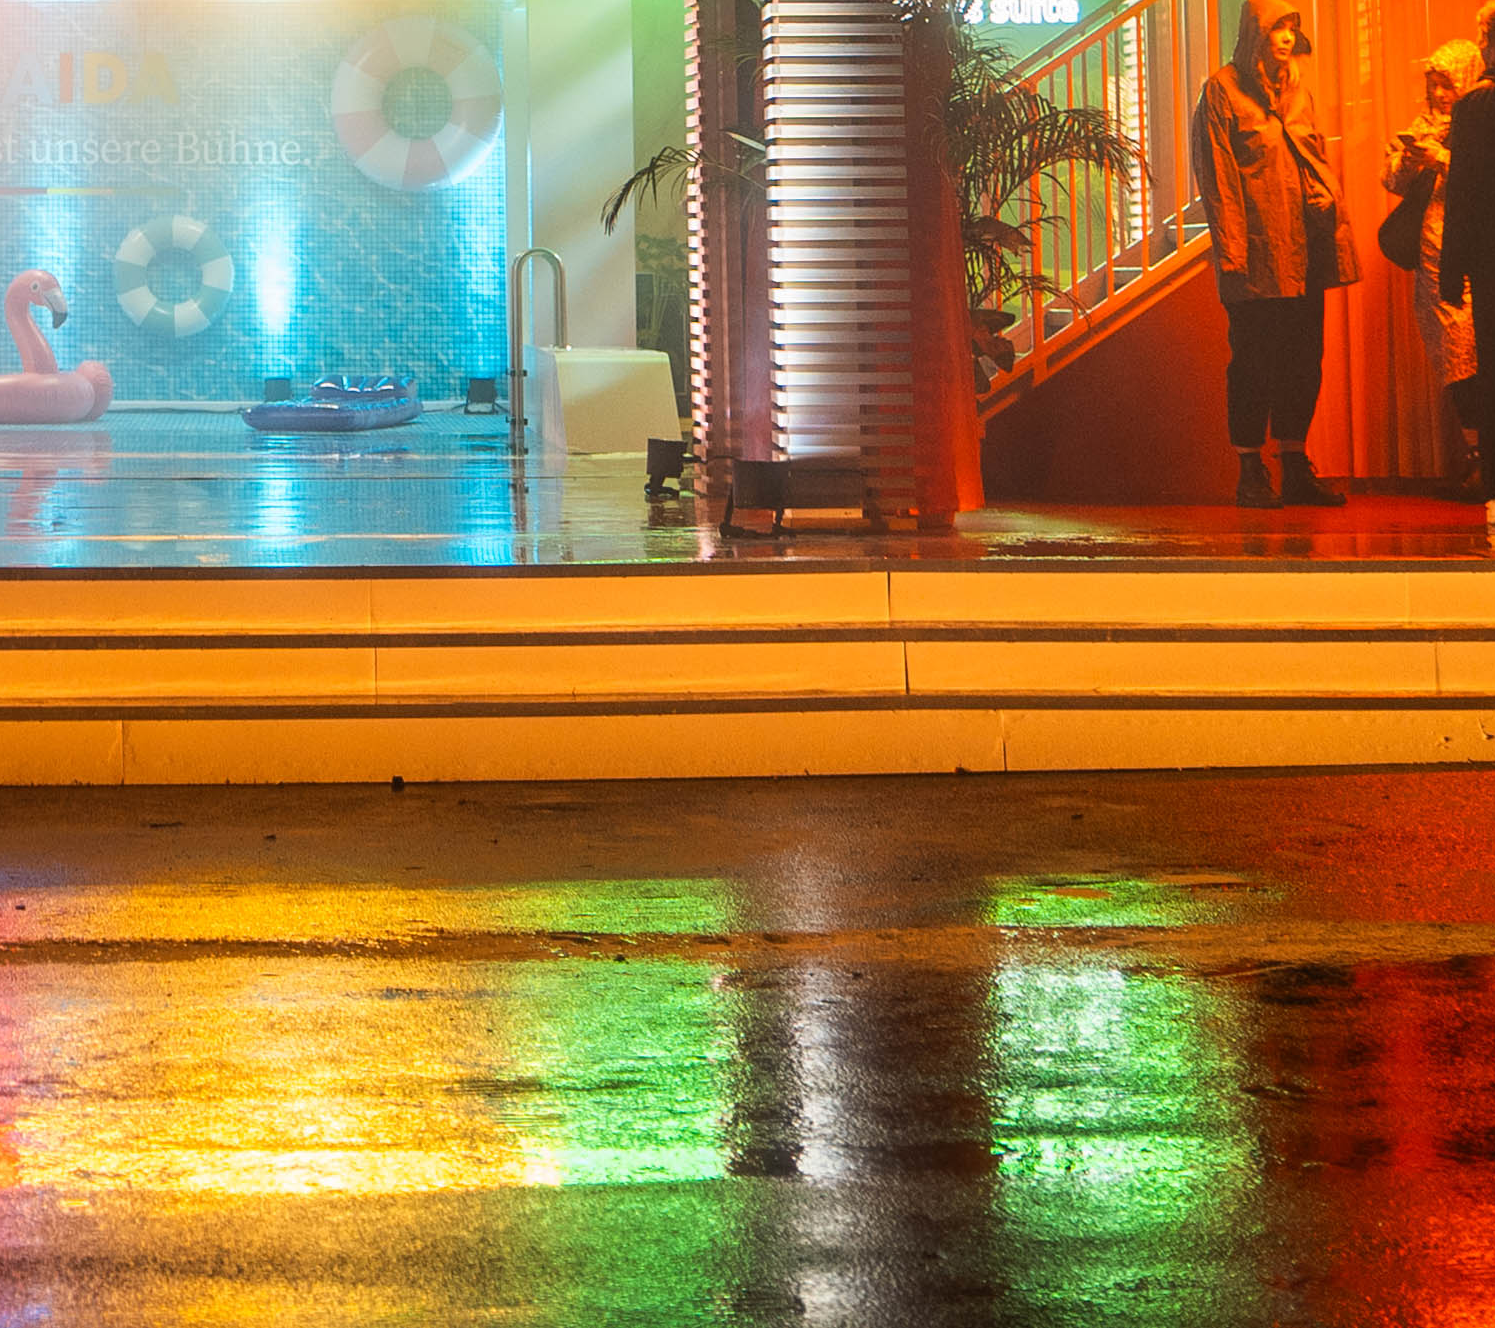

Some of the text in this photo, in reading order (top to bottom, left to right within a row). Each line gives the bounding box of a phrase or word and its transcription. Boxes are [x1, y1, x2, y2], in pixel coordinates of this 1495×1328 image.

[2, 49, 180, 105] AIDA
[28, 139, 155, 165] unsere
[172, 129, 312, 168] Bühne.
